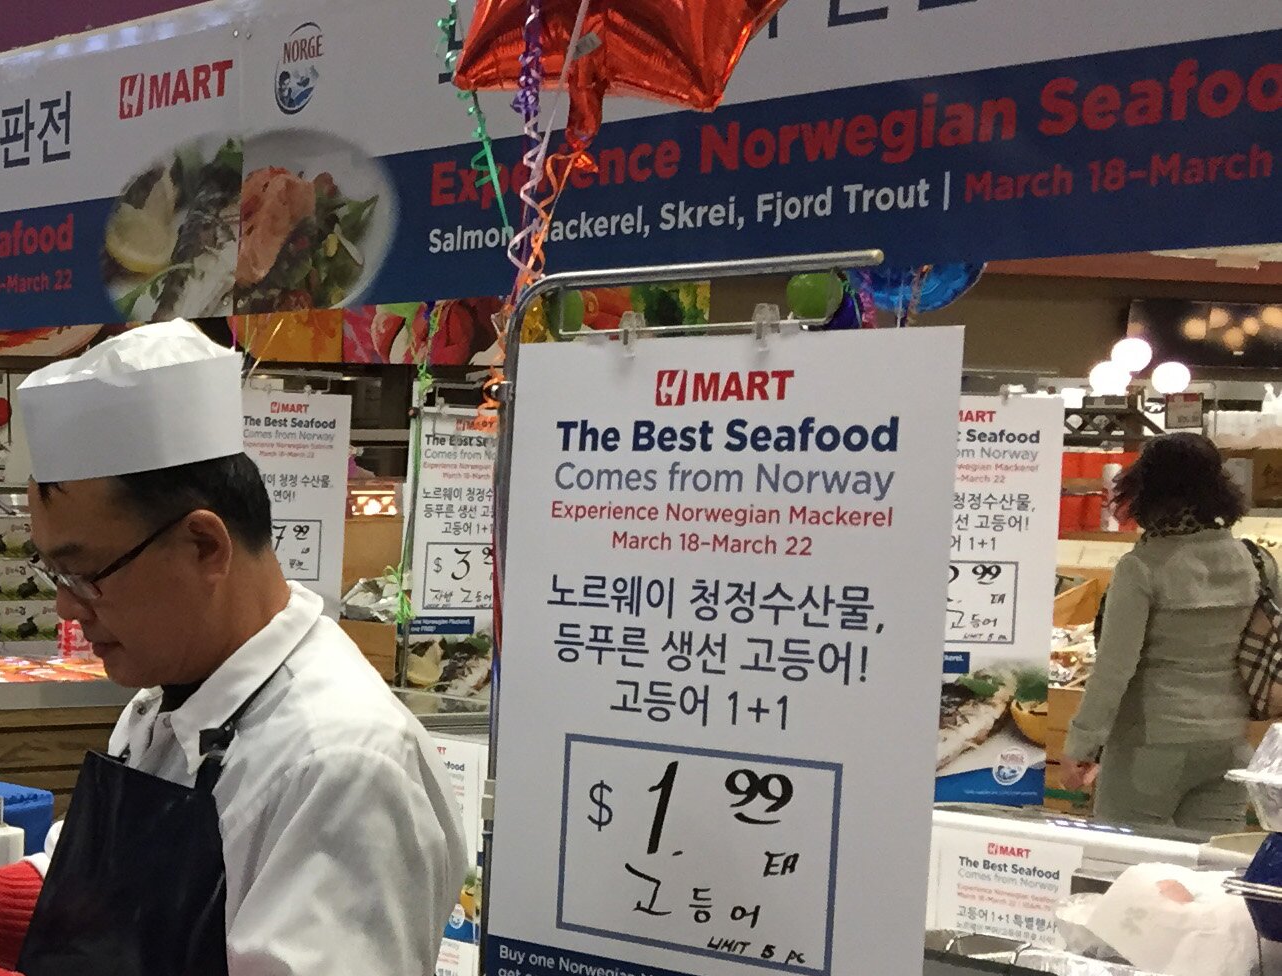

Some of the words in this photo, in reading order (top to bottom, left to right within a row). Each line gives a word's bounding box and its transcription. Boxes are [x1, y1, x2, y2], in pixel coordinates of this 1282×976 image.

[282, 35, 324, 65] NORGE
[148, 59, 233, 110] MART
[699, 94, 1017, 172] Norwegian
[659, 196, 744, 233] Skrei,
[756, 187, 832, 227] Fjord
[844, 178, 931, 214] Trout
[964, 164, 1075, 202] March
[54, 269, 73, 291] 22
[691, 370, 795, 402] MART
[281, 403, 310, 413] MART
[243, 416, 261, 426] The
[264, 417, 288, 427] Best
[290, 418, 336, 429] Seafood
[243, 429, 273, 439] Comes
[275, 429, 297, 440] from
[299, 431, 335, 442] Norway
[425, 434, 446, 446] The
[556, 420, 620, 452] The
[632, 419, 714, 453] Best
[724, 416, 899, 453] Seafood
[966, 429, 1041, 444] Seafood
[424, 448, 457, 460] Comes
[460, 450, 482, 460] from
[980, 446, 1039, 463] Norway
[555, 461, 657, 492] Comes
[668, 461, 744, 493] from
[756, 464, 896, 501] Norway
[993, 476, 1006, 484] 22
[422, 487, 463, 501] 노르웨이
[424, 504, 455, 519] 등푸른
[551, 501, 659, 523] Experience
[666, 503, 780, 528] Norwegian
[789, 505, 894, 527] Mackerel
[974, 514, 1029, 532] 고등어!
[293, 525, 310, 537] 99
[442, 522, 472, 536] 고등어
[612, 531, 672, 552] March
[785, 537, 814, 556] 22
[969, 536, 997, 551] 1+1
[433, 557, 443, 573] $
[451, 548, 472, 581] 3
[481, 547, 494, 560] 9
[971, 564, 1002, 581] 99
[547, 574, 676, 619] 노르웨이
[690, 579, 886, 635] 청정수산물,
[554, 623, 650, 668] 등푸른
[661, 631, 728, 676] 생선
[740, 637, 869, 687] 고등어!
[609, 680, 711, 728] 고등어
[727, 690, 790, 731] 1+1
[587, 779, 614, 833] $
[724, 768, 794, 814] 99
[999, 846, 1031, 859] MART
[763, 851, 801, 878] EA
[959, 856, 980, 869] The
[982, 860, 1008, 873] Best
[1011, 864, 1060, 880] Seafood
[958, 868, 992, 881] Comes
[1020, 878, 1059, 893] Norway
[499, 945, 525, 965] Buy
[528, 953, 555, 968] one
[707, 936, 751, 955] LIMIT
[760, 944, 776, 959] 5
